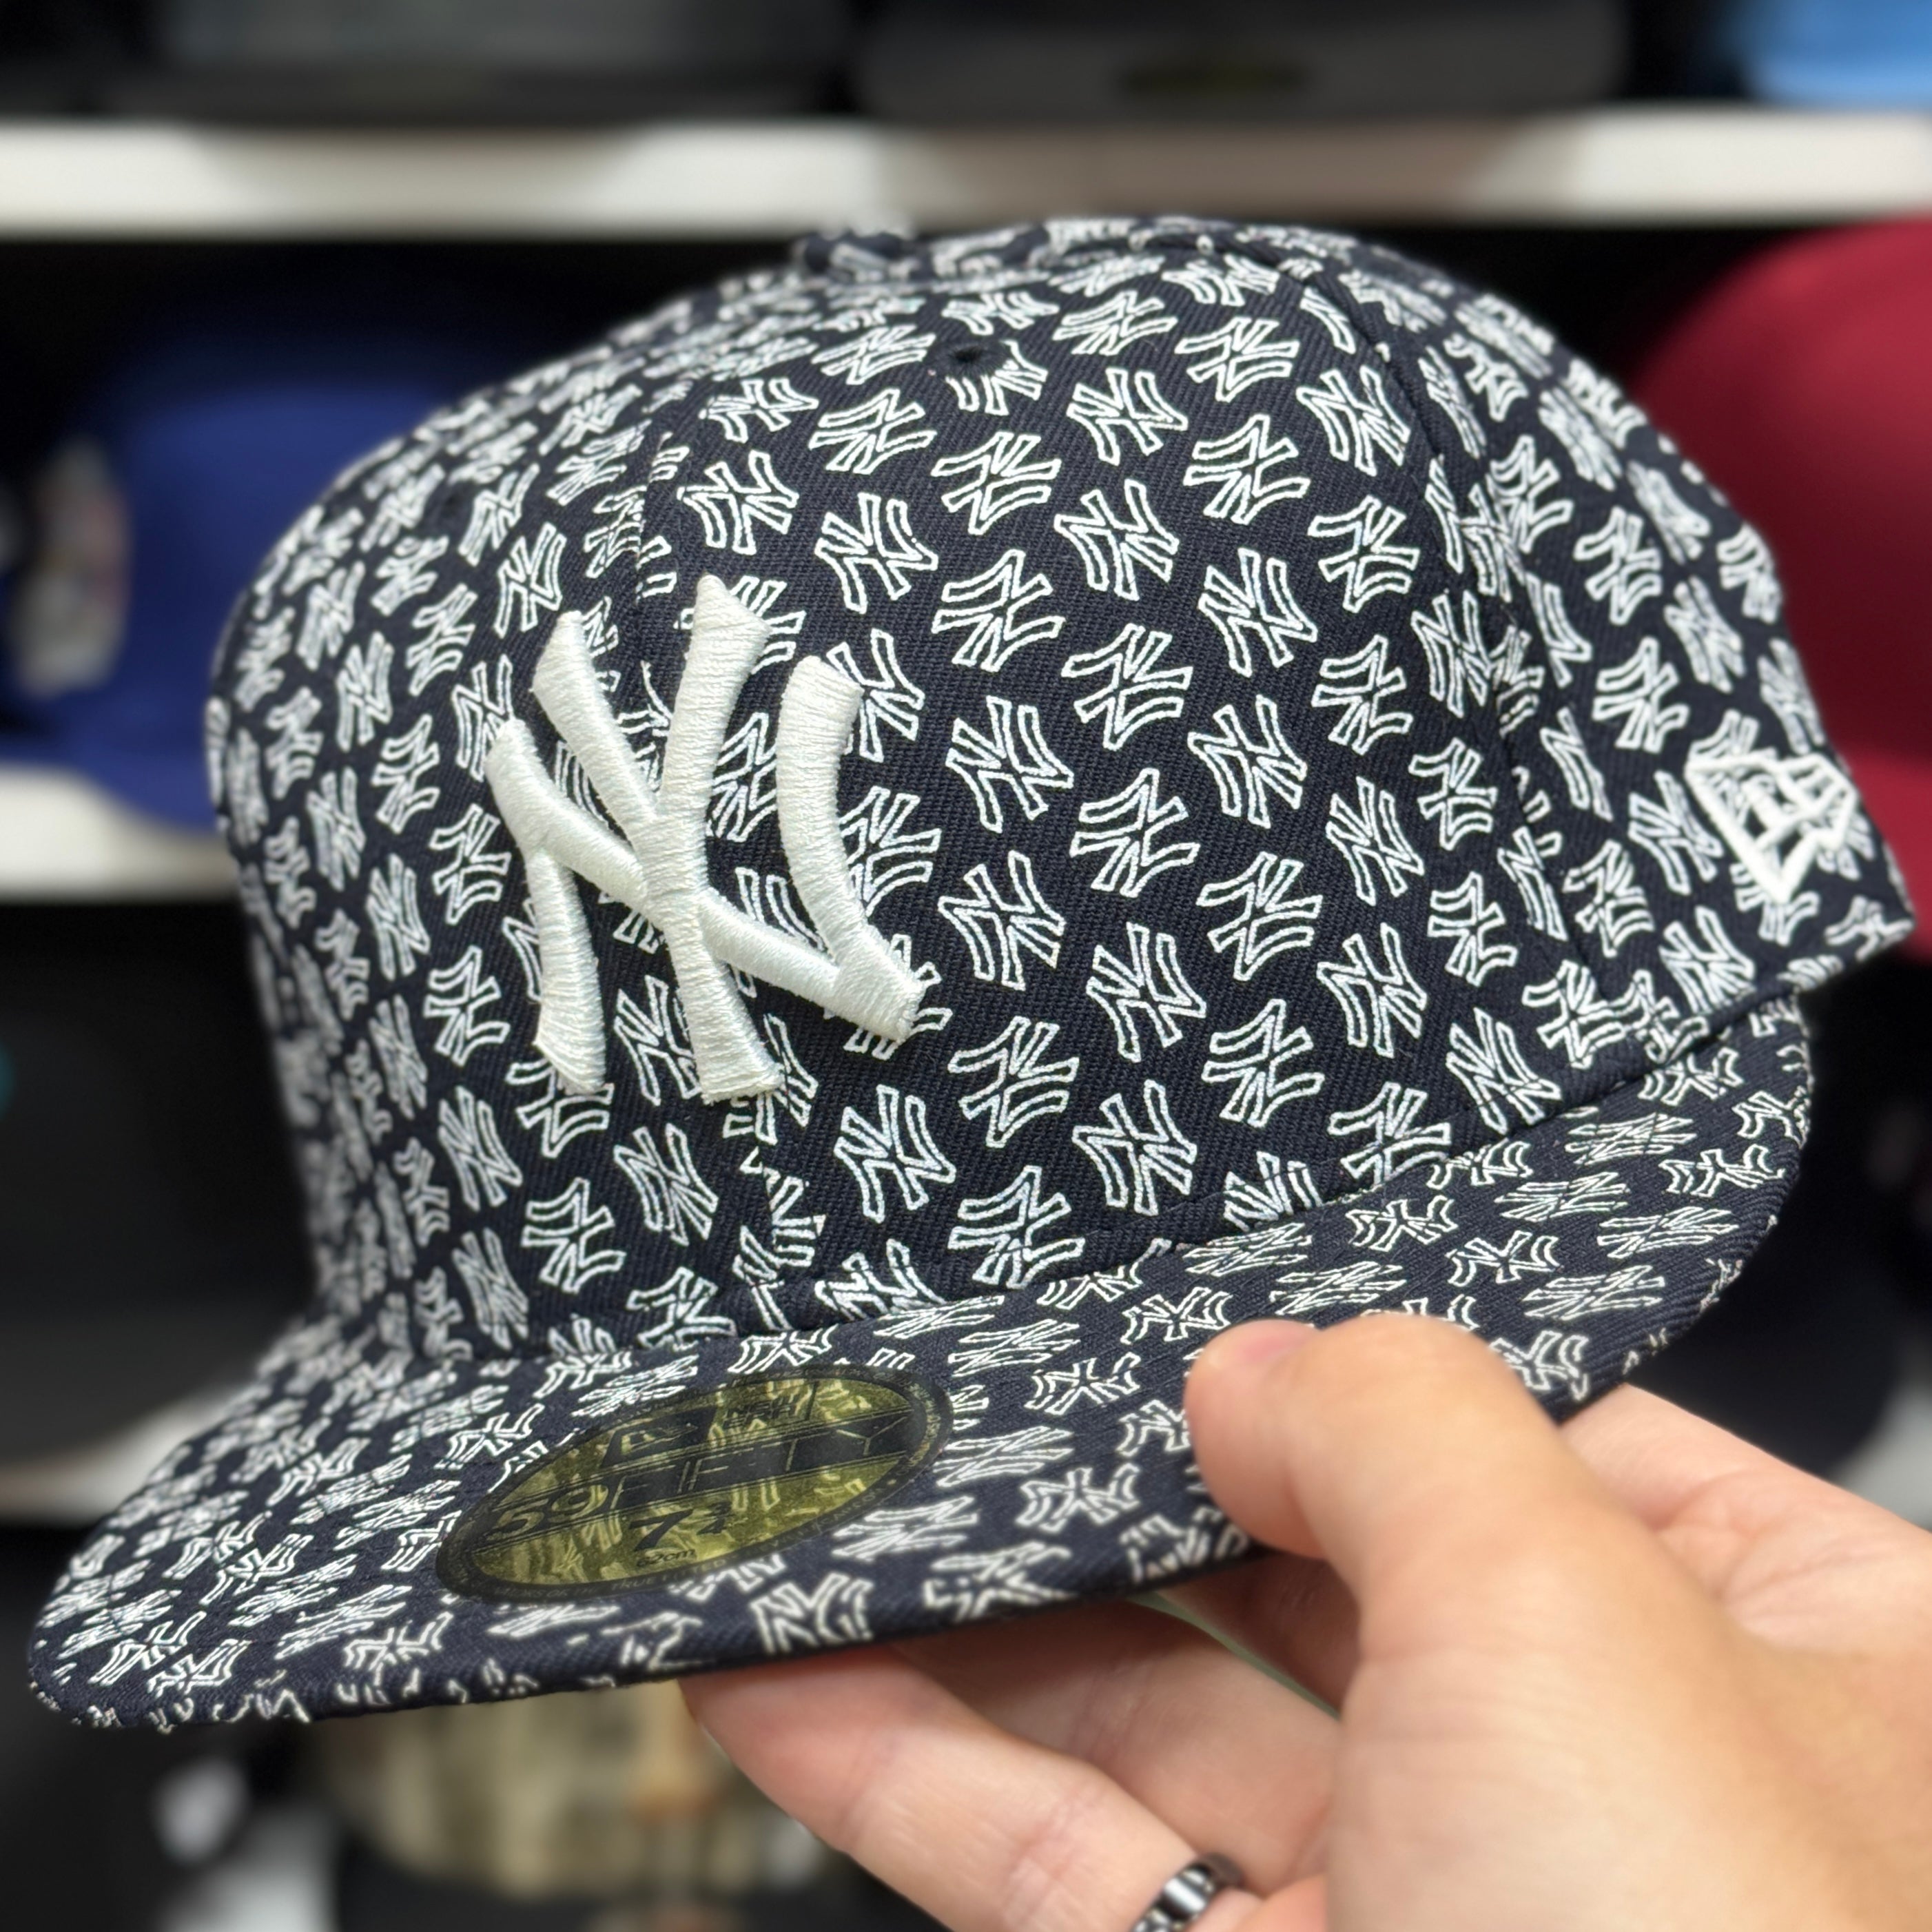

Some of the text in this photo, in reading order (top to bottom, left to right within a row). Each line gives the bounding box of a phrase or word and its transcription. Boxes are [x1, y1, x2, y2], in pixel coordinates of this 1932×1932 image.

[1066, 366, 1189, 466] NY
[1174, 315, 1301, 403] NY
[1295, 364, 1411, 477] NY
[807, 387, 938, 475] NY
[930, 429, 1062, 535] NY
[1182, 412, 1311, 526] NY
[677, 451, 799, 554] NY
[813, 491, 939, 615] NY
[1052, 475, 1180, 602] NY
[1306, 494, 1421, 613] NY
[495, 522, 566, 639] NY
[930, 548, 1070, 673] NY
[1197, 546, 1319, 678] NY
[1574, 506, 1661, 624] NY
[1060, 622, 1193, 752] NY
[1311, 634, 1414, 756] NY
[1410, 588, 1498, 718] NY
[1593, 637, 1689, 753] NY
[372, 715, 440, 834] NY
[945, 695, 1074, 834] NY
[1187, 694, 1308, 829] NY
[1408, 737, 1498, 851] NY
[429, 803, 512, 925] NY
[485, 574, 927, 1104] NY
[1069, 767, 1201, 898] NY
[1326, 777, 1424, 906] NY
[937, 850, 1067, 991] NY
[1195, 851, 1324, 981] NY
[1428, 872, 1517, 987] NY
[1562, 841, 1654, 956] NY
[423, 945, 511, 1067] NY
[1085, 921, 1207, 1063] NY
[1316, 922, 1428, 1058] NY
[947, 1016, 1080, 1148] NY
[1201, 998, 1325, 1129] NY
[1447, 1007, 1561, 1133] NY
[439, 1087, 523, 1211] NY
[613, 1123, 719, 1246] NY
[833, 1084, 957, 1224] NY
[1071, 1079, 1198, 1216] NY
[521, 1177, 626, 1294] NY
[947, 1165, 1086, 1290] NY
[637, 1549, 696, 1568] 62cm
